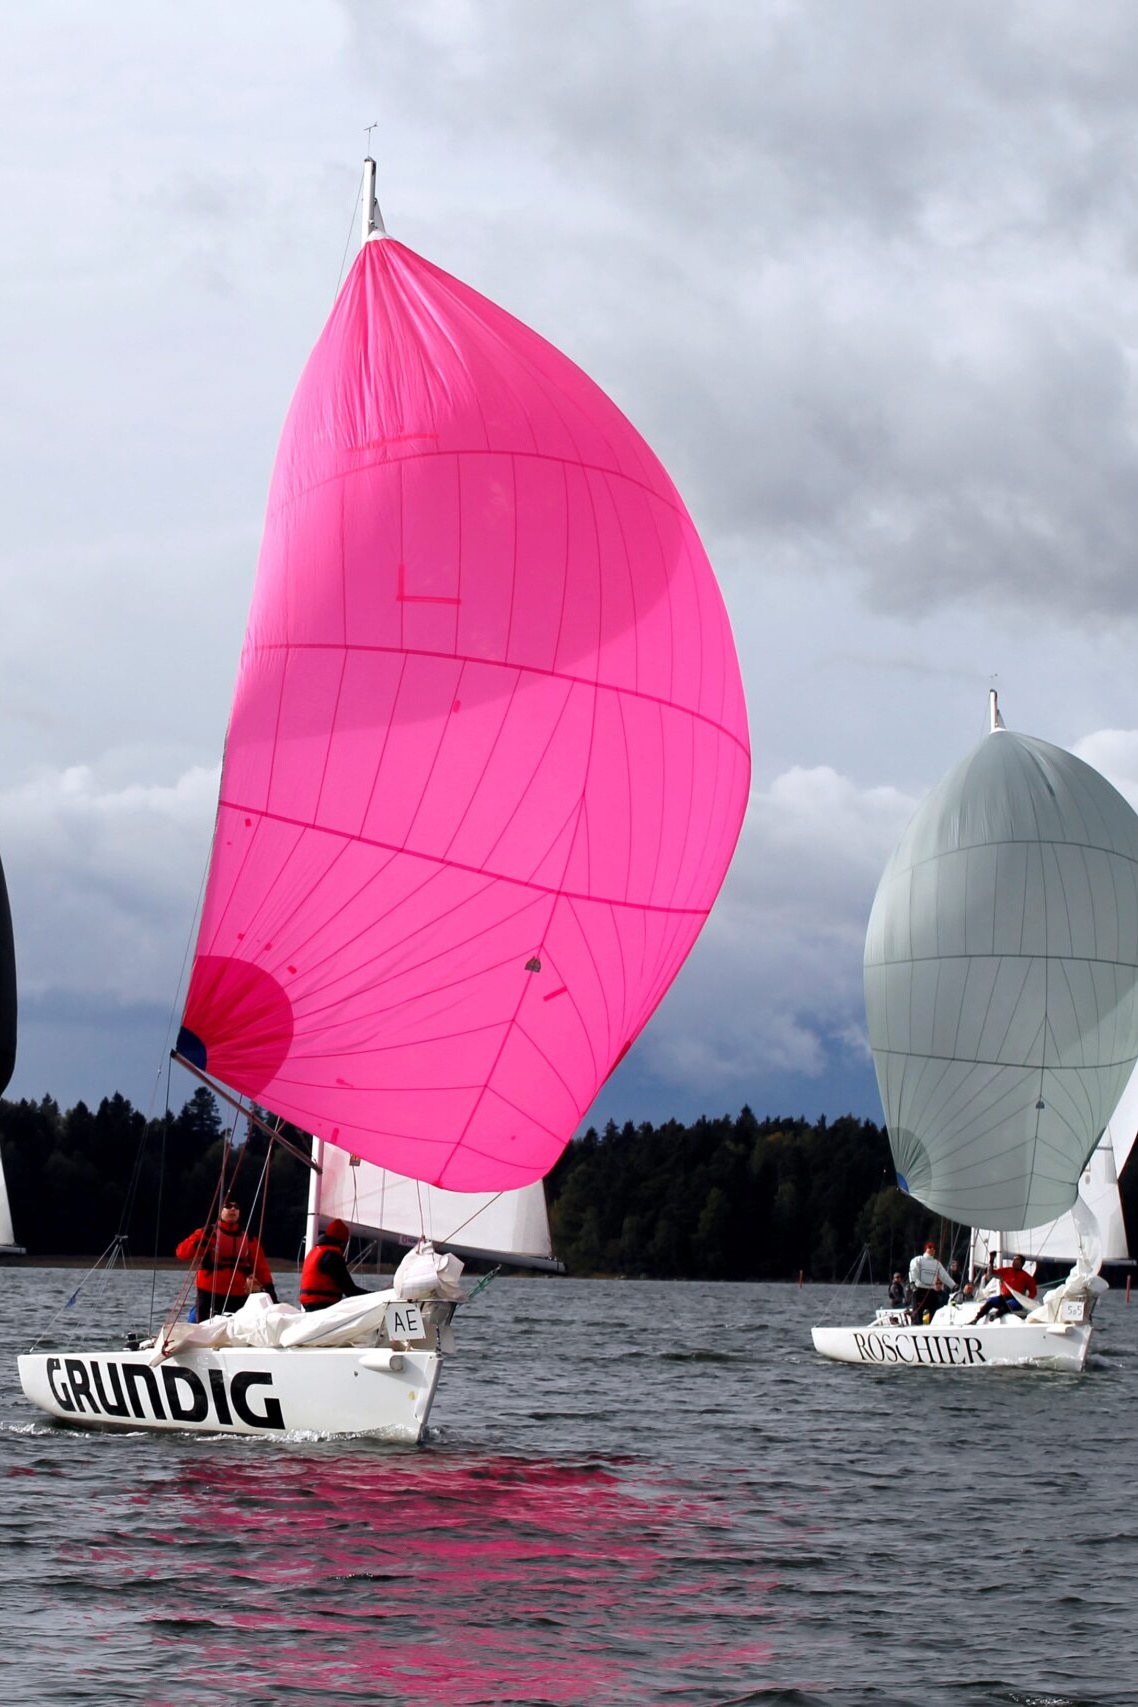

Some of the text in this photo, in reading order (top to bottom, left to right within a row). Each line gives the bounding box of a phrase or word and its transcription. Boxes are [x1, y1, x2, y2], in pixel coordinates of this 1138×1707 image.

[394, 1309, 418, 1333] AE
[853, 1332, 987, 1365] ROSCHIER
[46, 1357, 286, 1430] GRUNDIG
